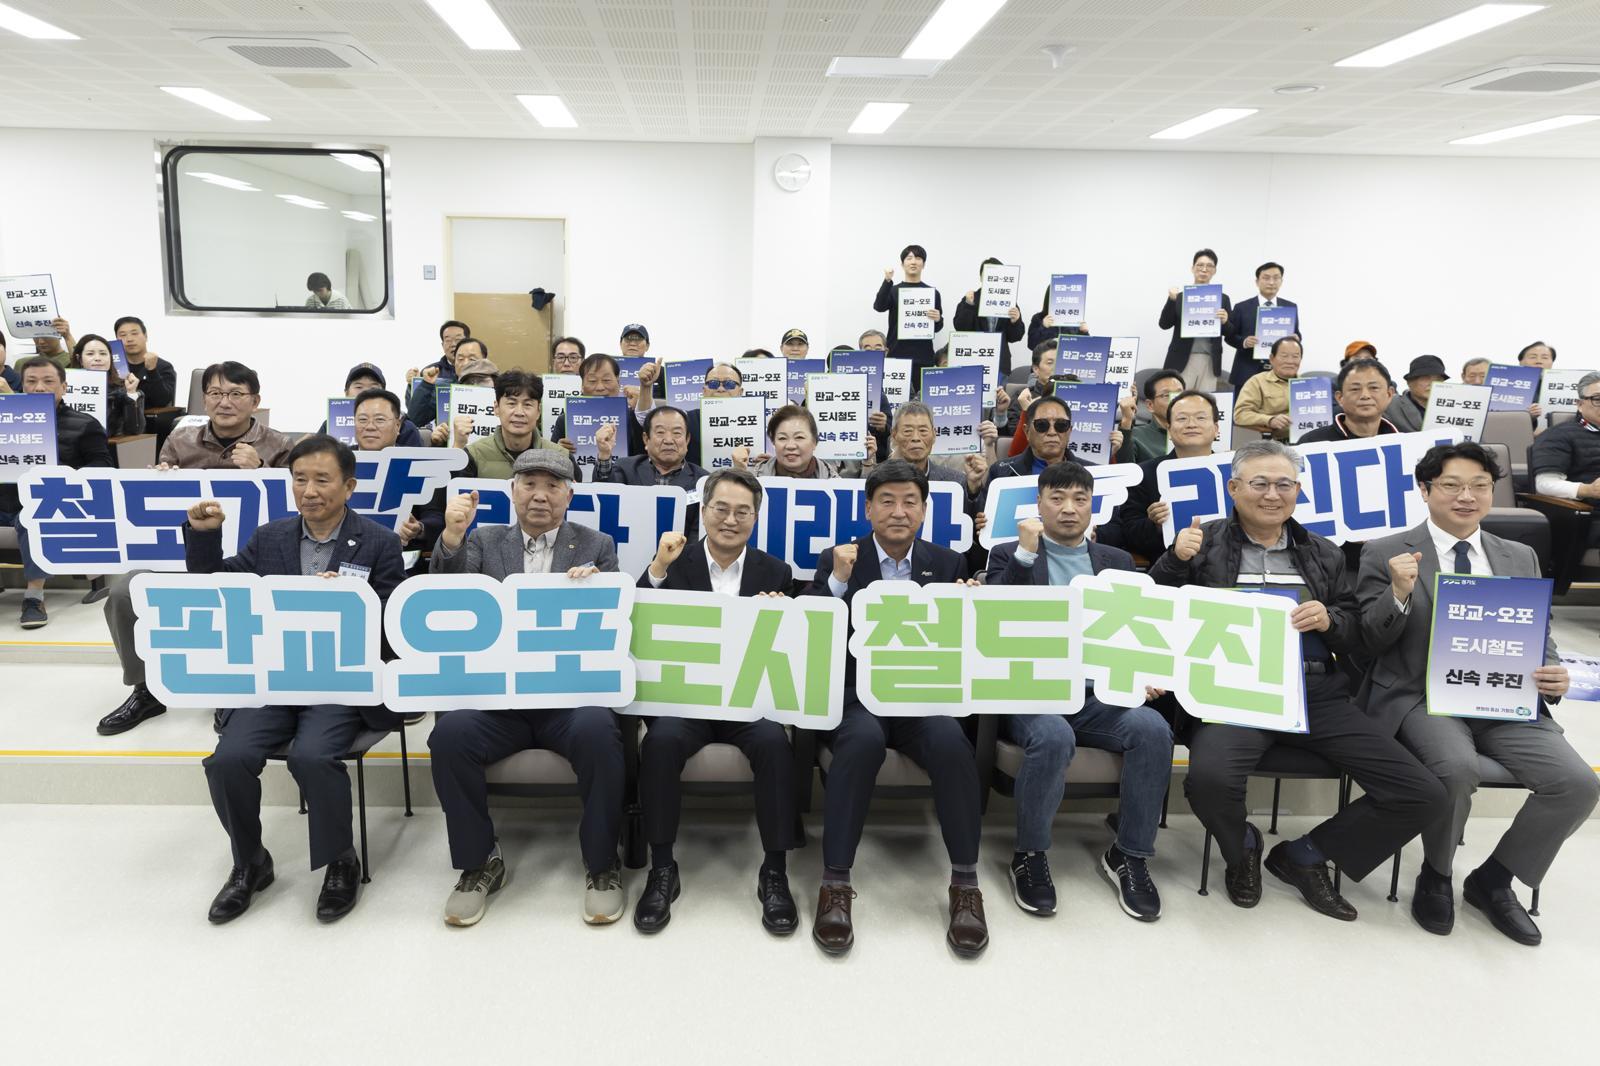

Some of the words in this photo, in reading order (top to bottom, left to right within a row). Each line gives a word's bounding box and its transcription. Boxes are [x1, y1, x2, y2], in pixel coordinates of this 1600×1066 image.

[987, 275, 1015, 283] 판교~오포
[6, 288, 48, 299] 판교~오포
[988, 287, 1011, 295] 도시철도
[903, 298, 931, 306] 판교~오포
[12, 304, 48, 314] 도시철도
[15, 320, 33, 328] 신속
[34, 319, 52, 327] 추진
[955, 347, 995, 357] 판교~오포
[1062, 350, 1102, 361] 판교~오포
[1108, 351, 1133, 359] 교~오포
[1106, 366, 1129, 374] 시철도
[742, 373, 781, 382] 판교~오포
[1491, 377, 1532, 390] 판교~오포
[1548, 382, 1578, 391] 판교~오
[66, 385, 100, 395] 교~오포
[549, 389, 583, 398] 판교~오
[929, 384, 976, 397] 판교~오포
[815, 391, 860, 401] 판교~오포
[1491, 393, 1525, 405] 도시철도
[66, 403, 96, 412] 시철도
[1436, 397, 1481, 410] 판교~오포
[457, 403, 495, 416] 판교~오
[932, 405, 972, 417] 도시철도
[573, 415, 620, 426] 판교~오포
[709, 415, 758, 427] 판교~오포
[818, 411, 857, 421] 도시철도
[1435, 415, 1475, 427] 도시철도
[953, 425, 972, 436] 추진
[1072, 422, 1103, 433] 시철도
[1298, 421, 1314, 429] 신속
[713, 436, 754, 448] 도시철도
[818, 431, 836, 442] 신속
[839, 431, 859, 442] 추진
[1069, 442, 1079, 452] 속
[1080, 441, 1102, 453] 추진
[23, 454, 46, 465] 추진
[577, 455, 597, 465] 신속
[712, 457, 732, 468] 신속
[1448, 603, 1534, 625] 판교~오포
[1451, 636, 1524, 657] 도시철도
[1446, 669, 1481, 686] 신속
[1486, 672, 1523, 689] 추진
